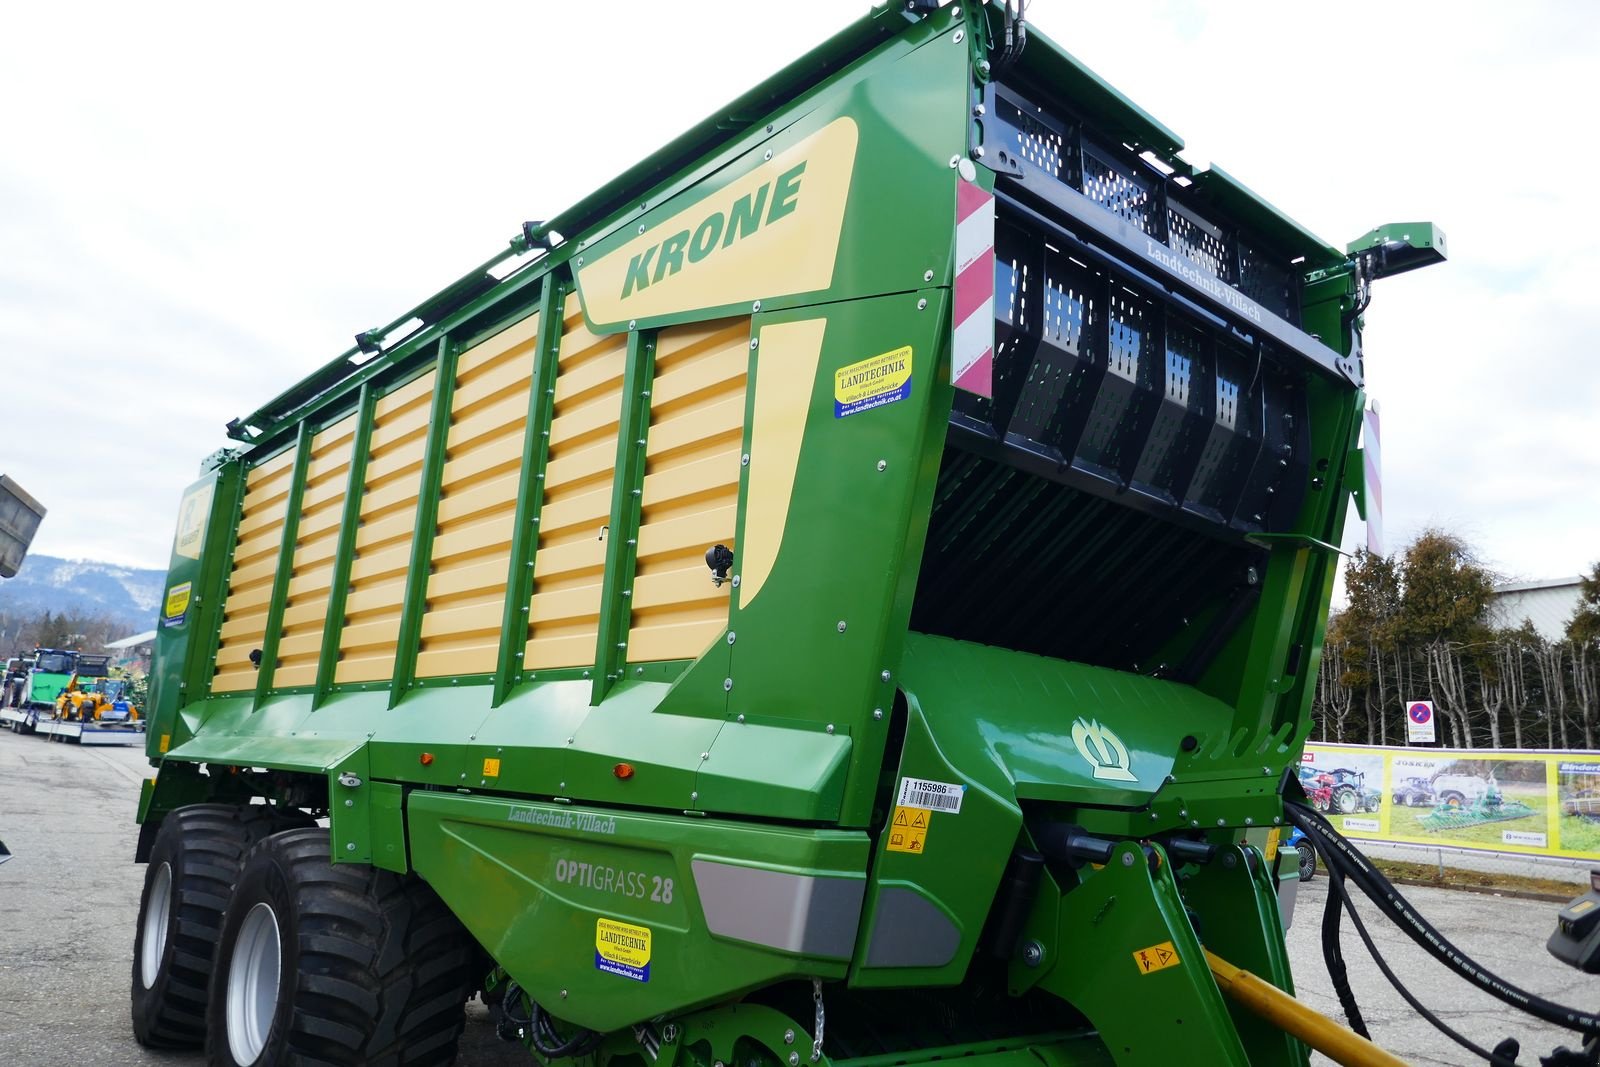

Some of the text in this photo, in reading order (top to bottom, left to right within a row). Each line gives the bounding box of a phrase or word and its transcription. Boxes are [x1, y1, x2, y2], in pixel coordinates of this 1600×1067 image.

[620, 160, 807, 300] KRONE
[841, 359, 905, 389] LANDTECHNIK
[841, 394, 902, 417] www.landtechnik.co.at
[914, 781, 947, 794] 1155986
[556, 858, 674, 905] OPTIGRASS 28
[600, 930, 646, 951] LANDTECHNIK
[600, 963, 643, 981] www.landtechnik.co.at
